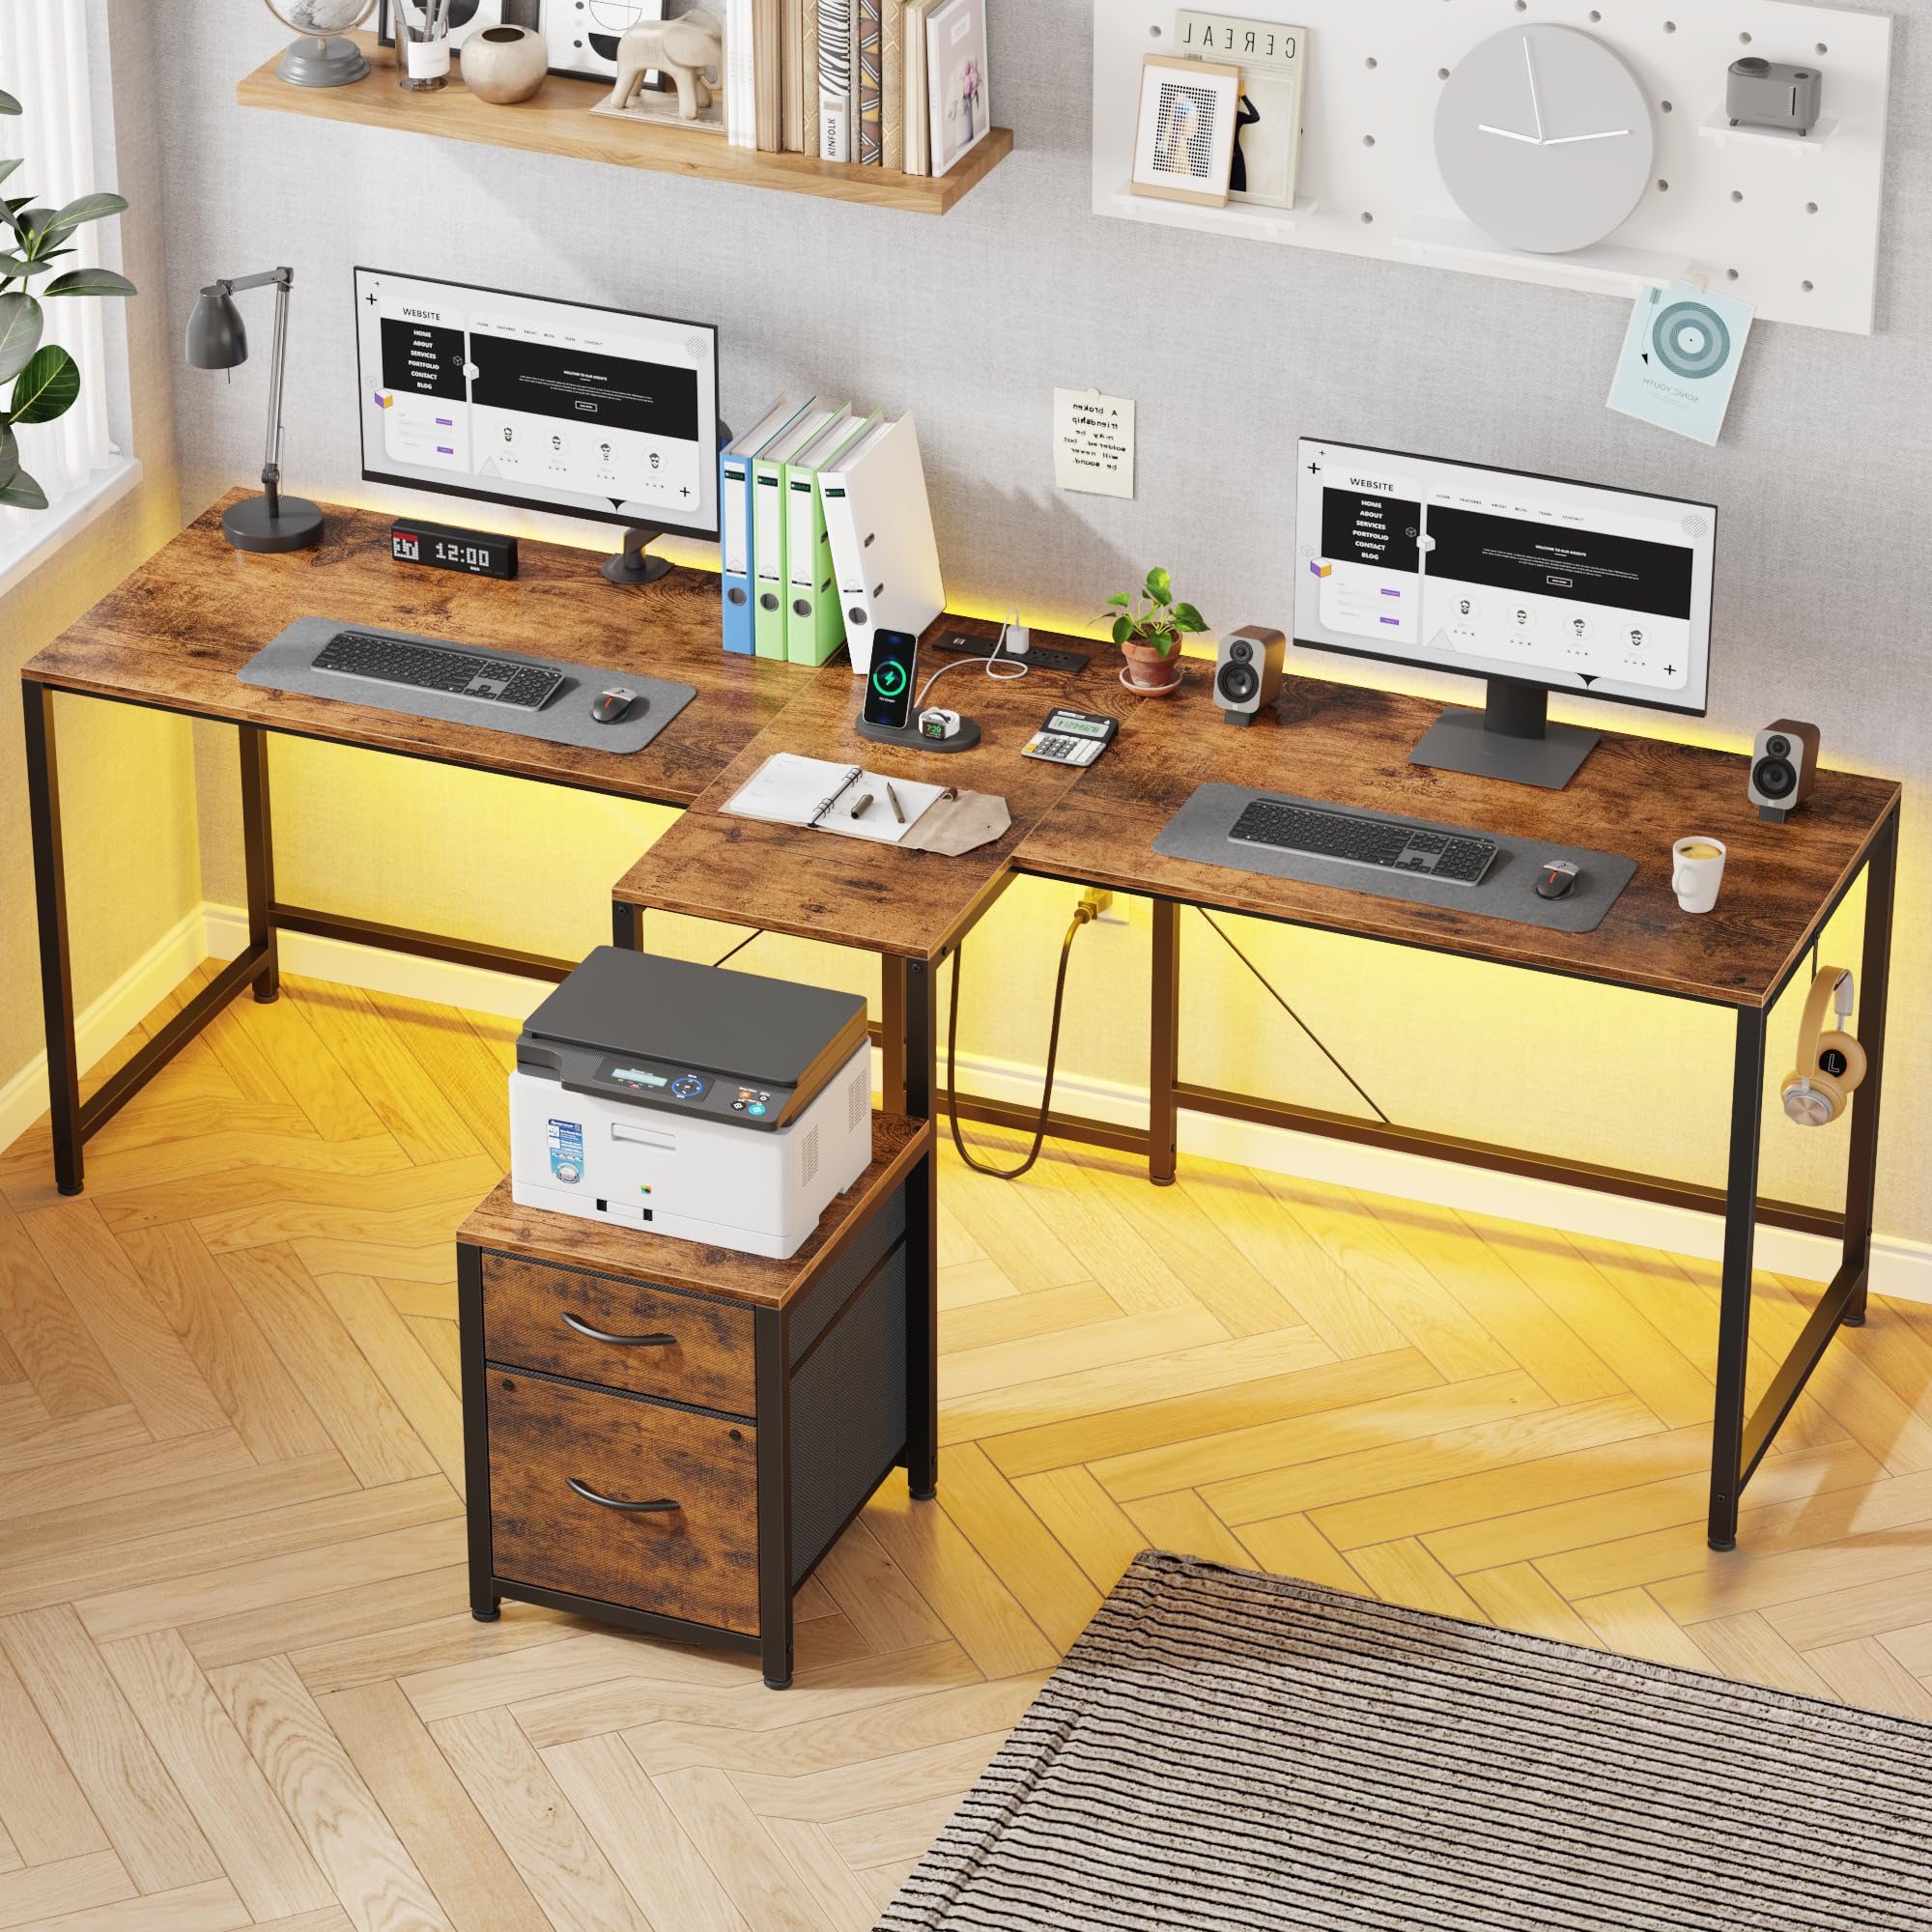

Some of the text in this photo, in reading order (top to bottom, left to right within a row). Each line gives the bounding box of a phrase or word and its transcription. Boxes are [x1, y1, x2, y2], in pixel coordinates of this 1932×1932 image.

[403, 307, 440, 321] WEBSITE
[413, 329, 432, 338] HOME
[411, 350, 437, 359] SERVICES
[408, 359, 440, 370] PORTFOLIO
[411, 370, 438, 380] CONTACT
[1350, 477, 1394, 491] WEBSITE
[1361, 499, 1382, 508] HOME
[1360, 510, 1383, 519] ABOUT
[1356, 520, 1386, 529] SERVICES
[1352, 529, 1389, 540] PORTFOLIO
[1354, 541, 1386, 551] CONTACT
[436, 542, 489, 567] 12:00
[1361, 552, 1378, 560] BLOG
[1828, 1053, 1840, 1073] L
